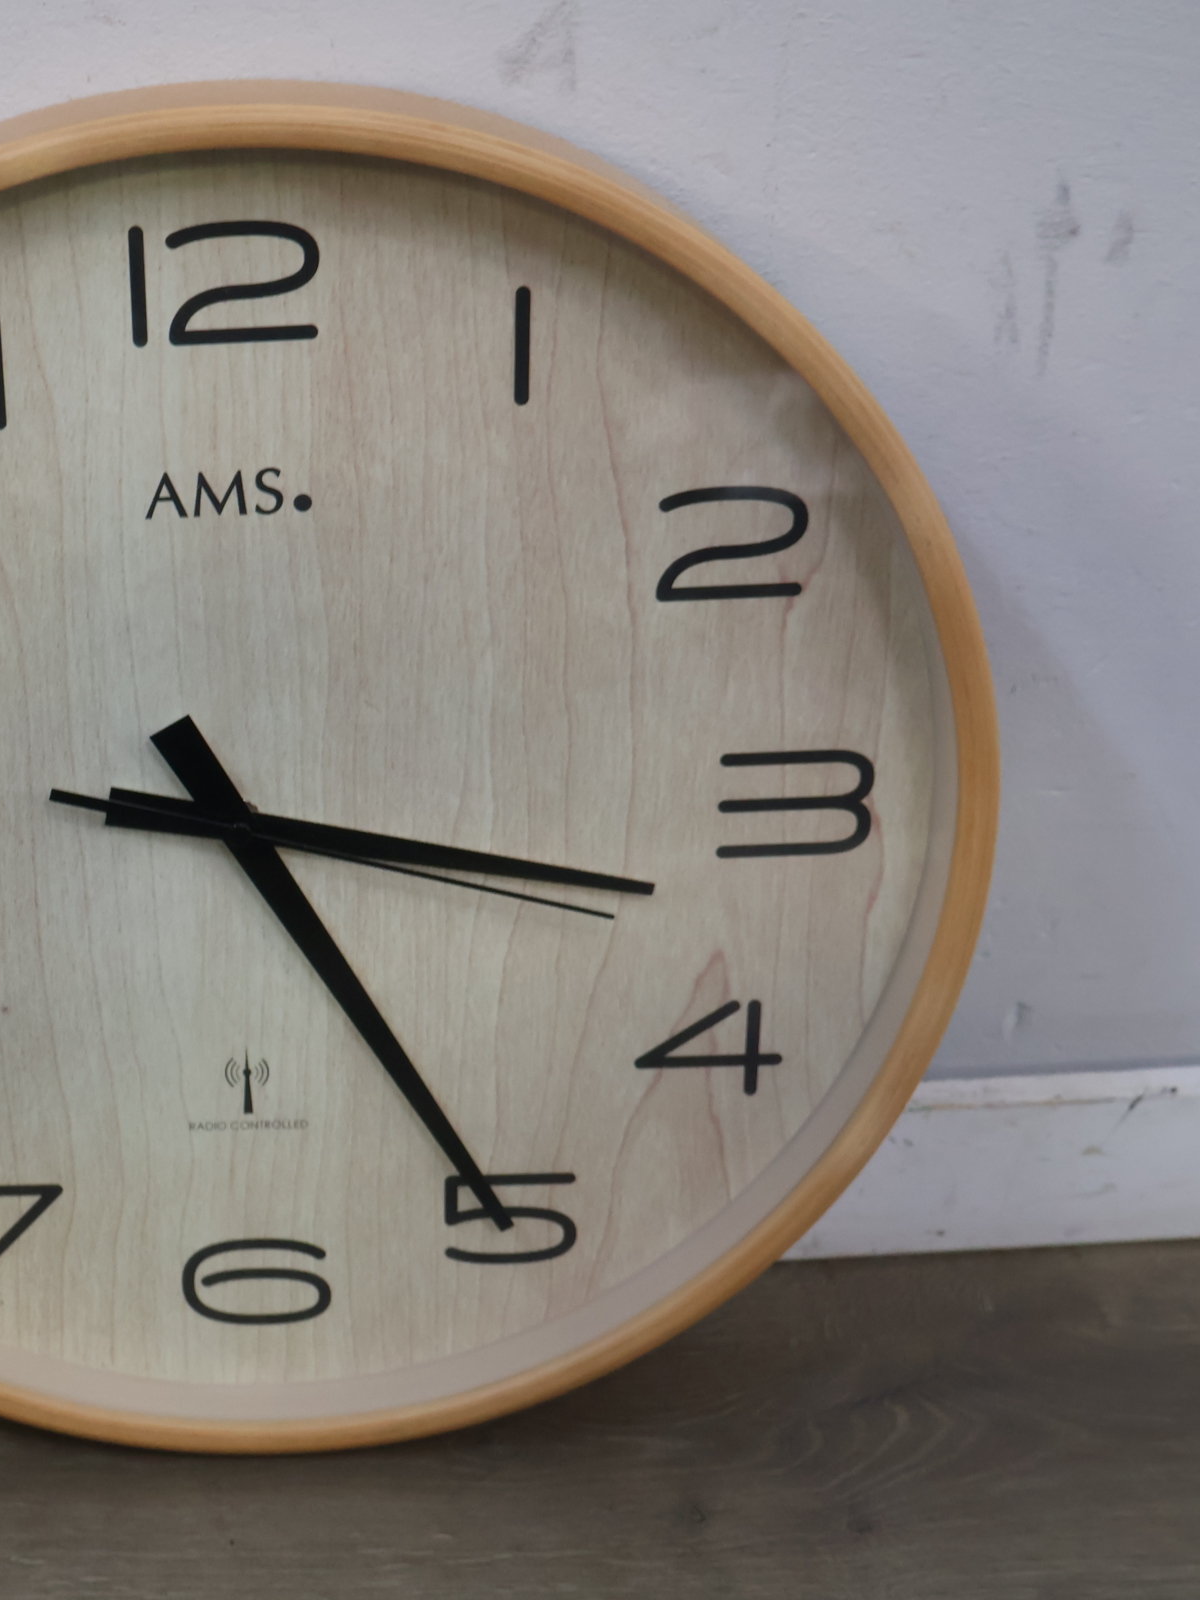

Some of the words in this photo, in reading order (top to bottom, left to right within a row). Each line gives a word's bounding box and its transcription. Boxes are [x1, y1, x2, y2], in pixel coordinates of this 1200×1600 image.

[128, 221, 320, 347] 12
[514, 286, 531, 405] 1
[656, 486, 809, 602] 2
[716, 750, 875, 858] 3
[634, 1000, 782, 1096] 4
[189, 1120, 226, 1131] RADIO
[230, 1119, 308, 1130] CONTROLLED
[444, 1172, 577, 1264] 5
[182, 1238, 331, 1325] 6
